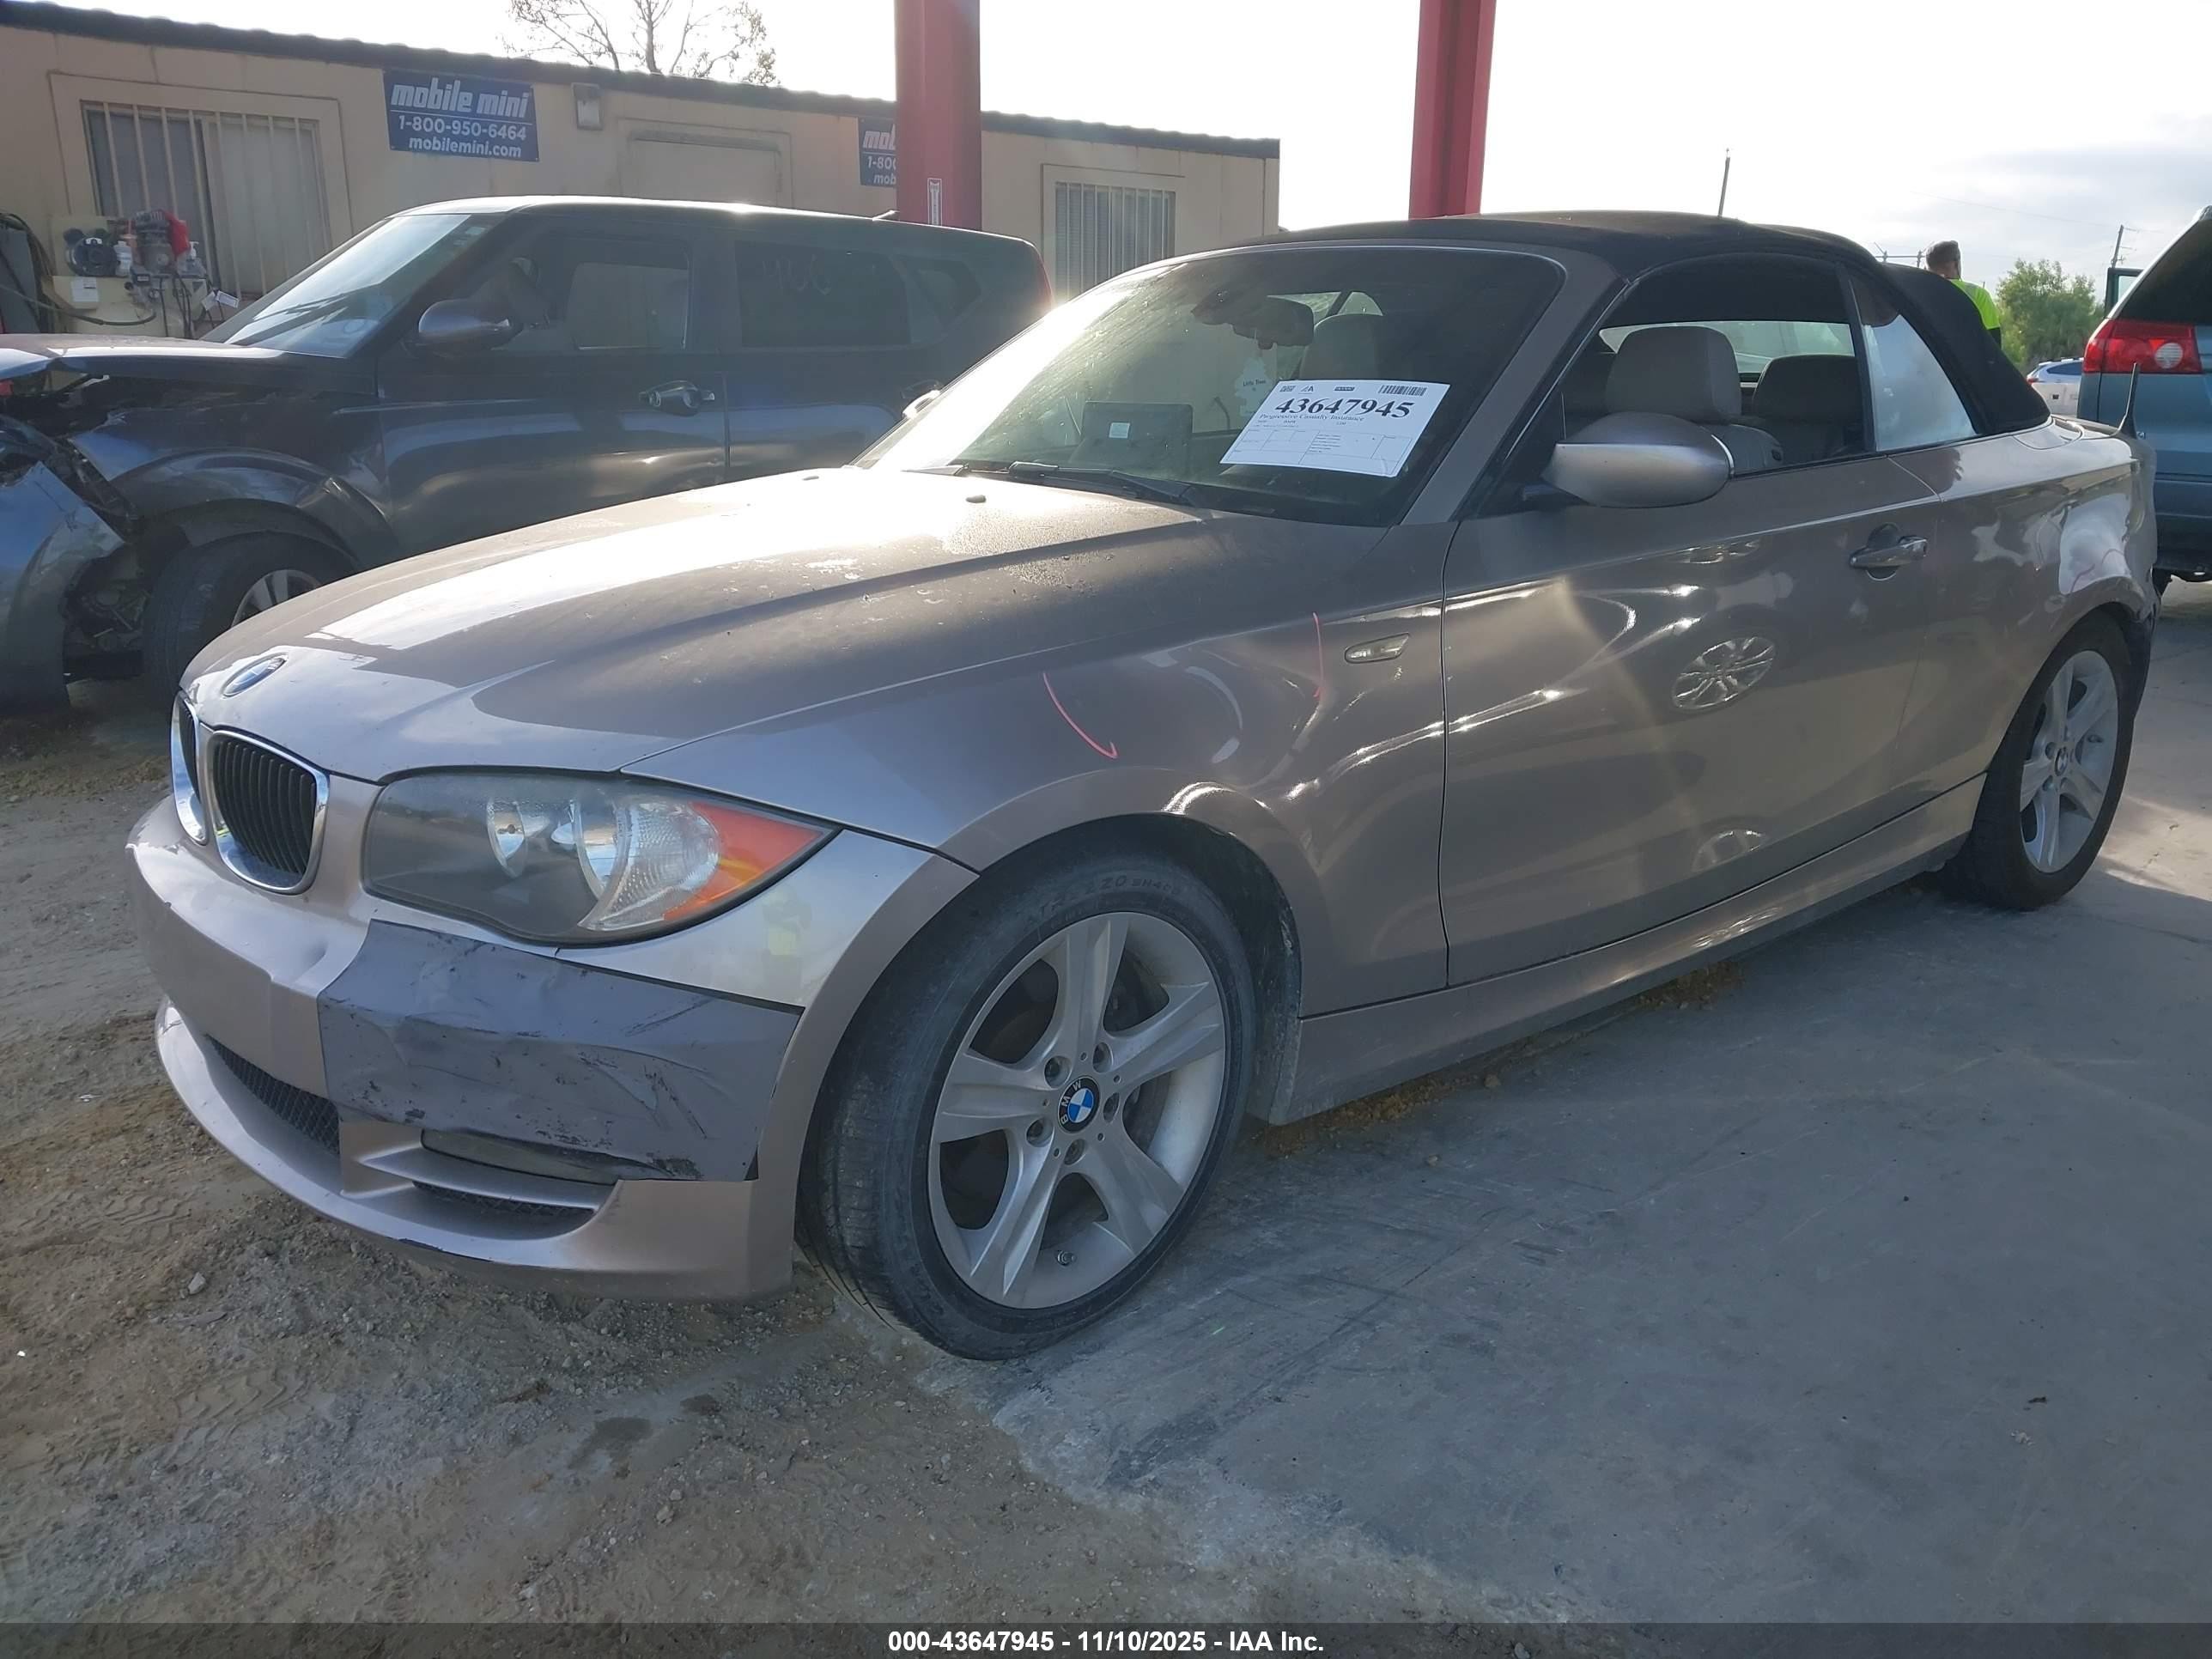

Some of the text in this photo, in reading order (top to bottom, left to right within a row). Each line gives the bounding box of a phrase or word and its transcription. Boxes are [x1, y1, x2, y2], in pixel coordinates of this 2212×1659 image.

[391, 77, 530, 118] mobile mini
[398, 115, 526, 141] 1-800-950-6464
[409, 137, 522, 158] mobilemini.com
[1274, 398, 1415, 418] 43647945
[1060, 1079, 1082, 1125] BMW
